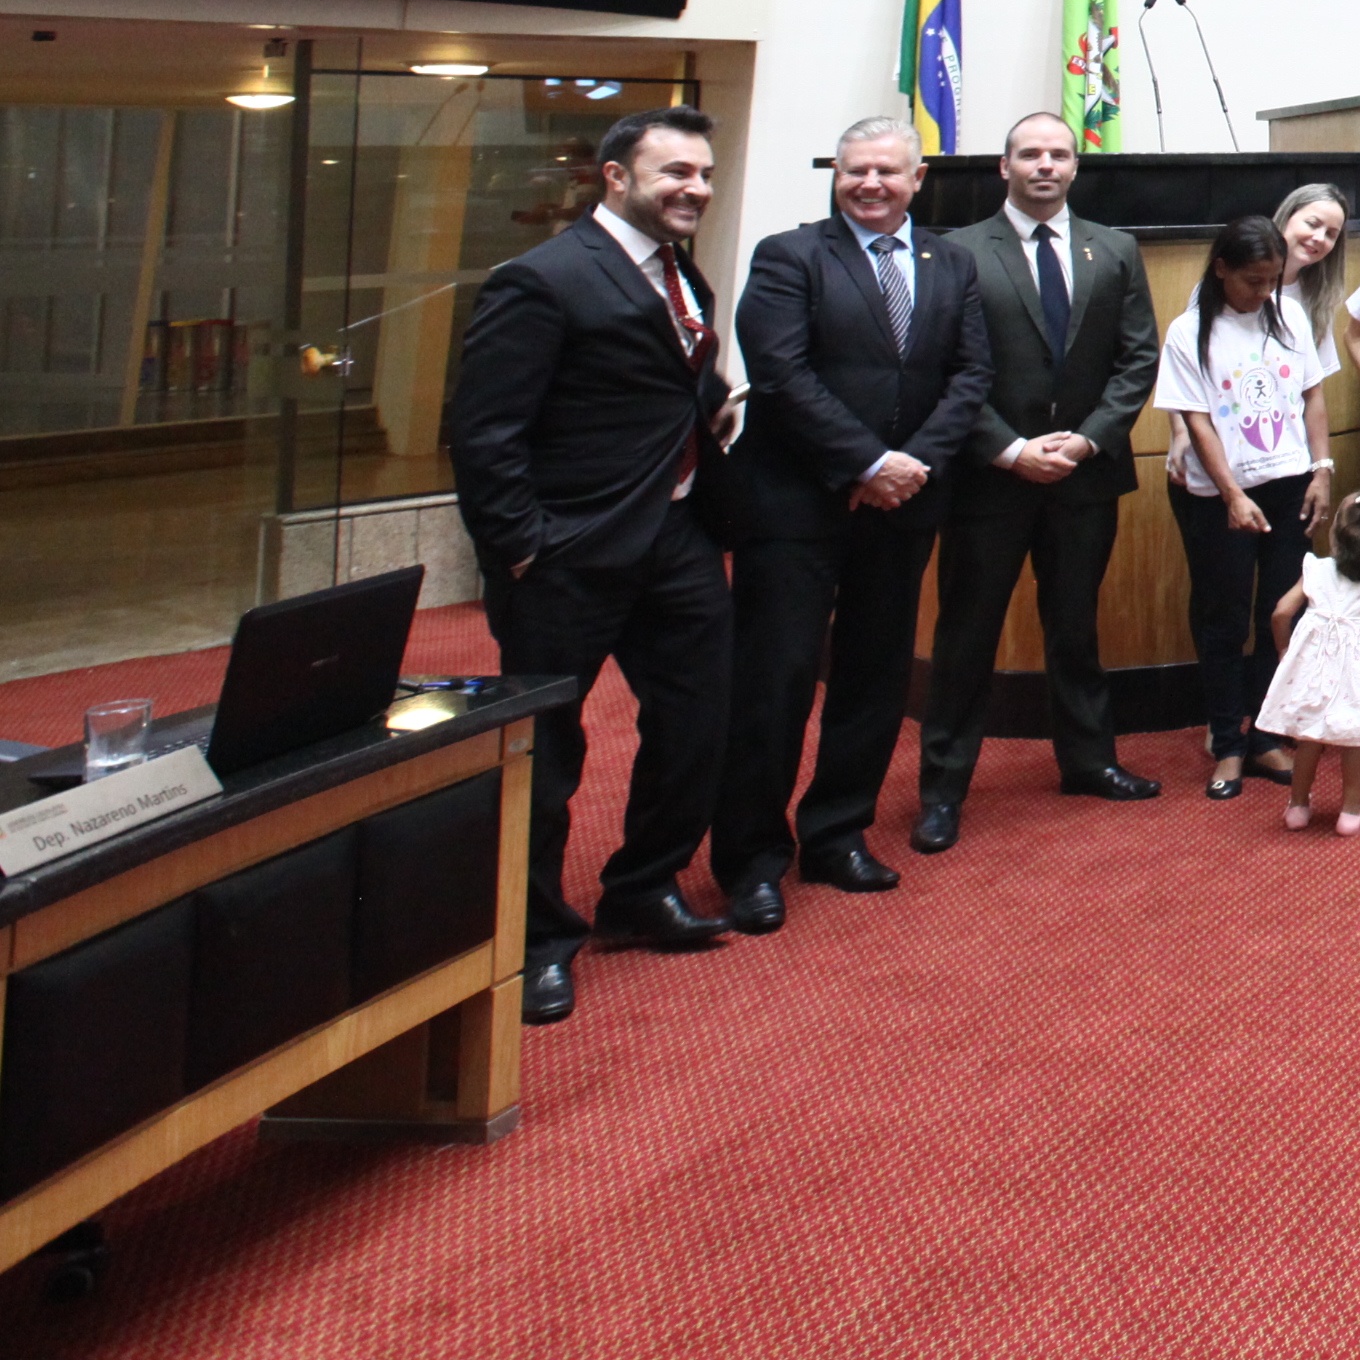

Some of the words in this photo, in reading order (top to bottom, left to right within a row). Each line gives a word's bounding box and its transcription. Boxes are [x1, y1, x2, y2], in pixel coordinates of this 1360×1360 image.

[33, 830, 70, 852] Dep.
[70, 803, 137, 837] Nazareno
[137, 782, 188, 811] Martins
